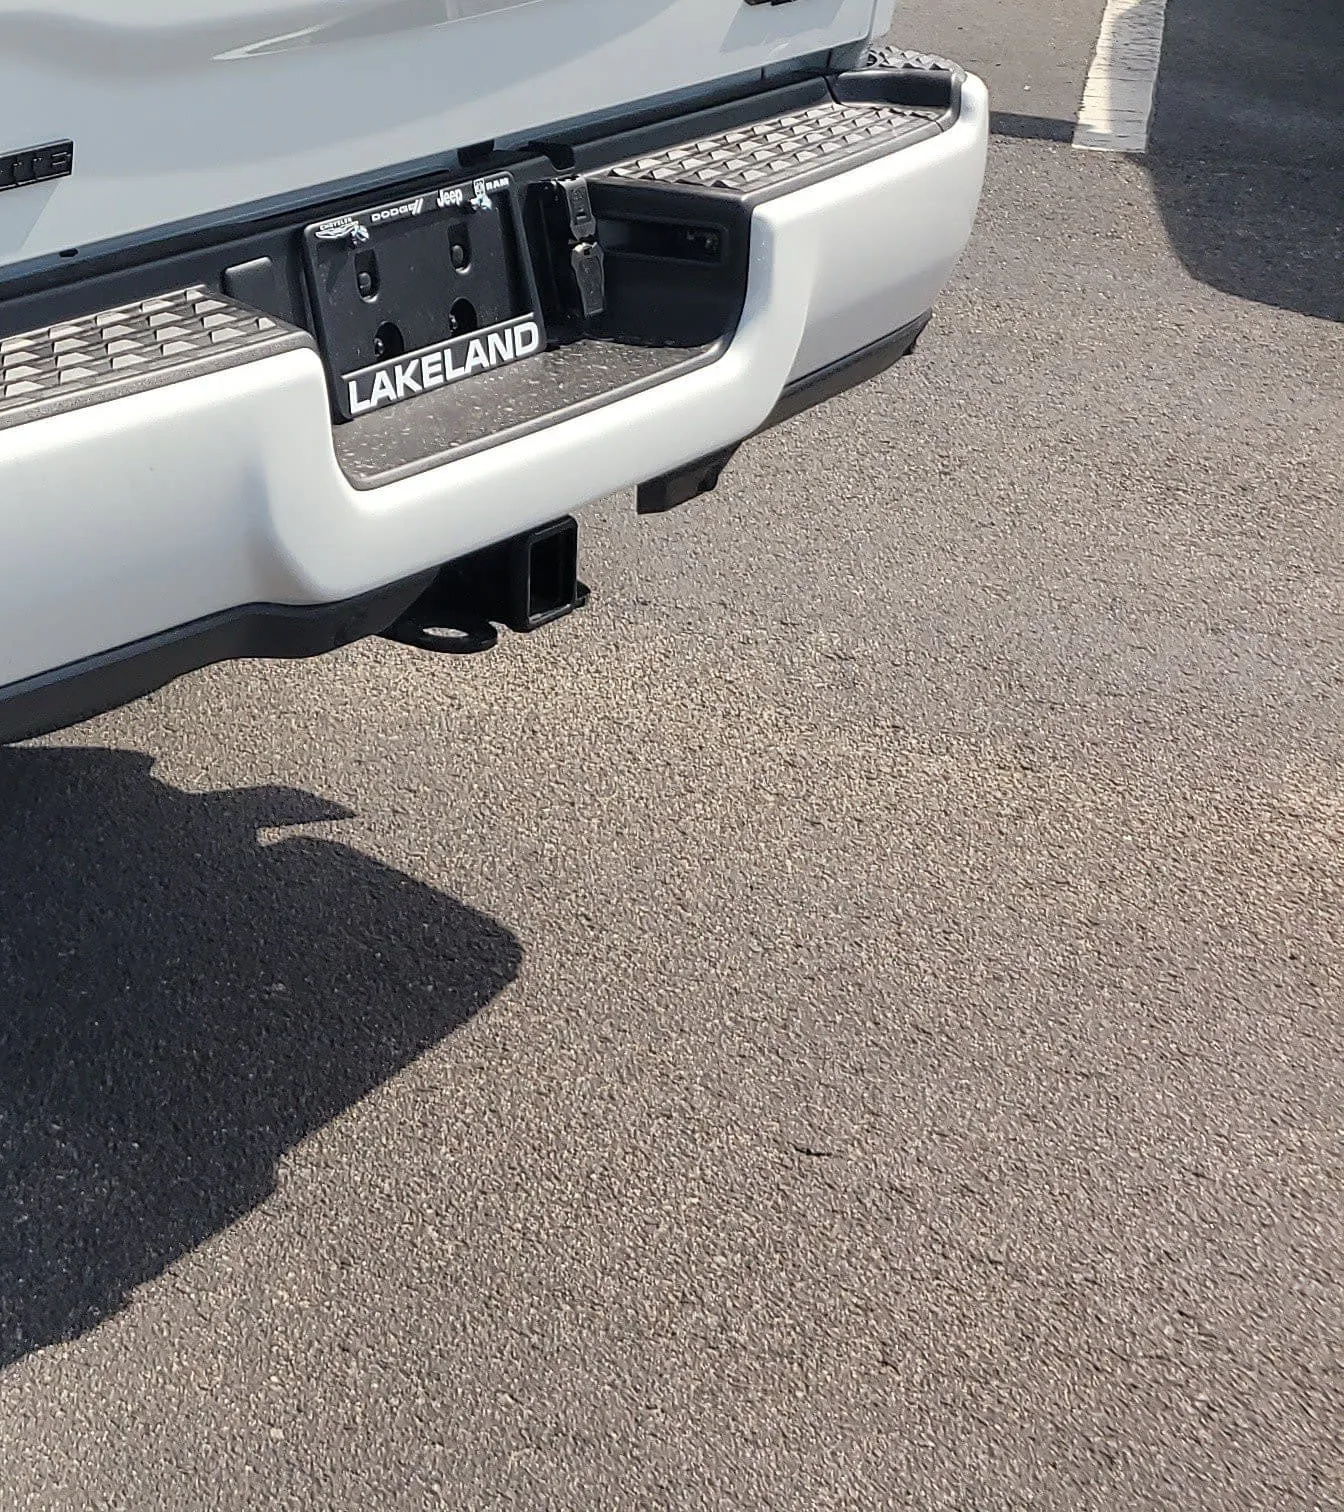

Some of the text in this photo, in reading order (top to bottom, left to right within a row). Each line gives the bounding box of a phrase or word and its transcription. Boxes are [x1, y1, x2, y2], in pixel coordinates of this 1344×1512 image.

[370, 202, 417, 223] DODGE
[437, 189, 463, 208] Jeep
[485, 178, 510, 191] RAM
[348, 321, 540, 416] LAKELAND
